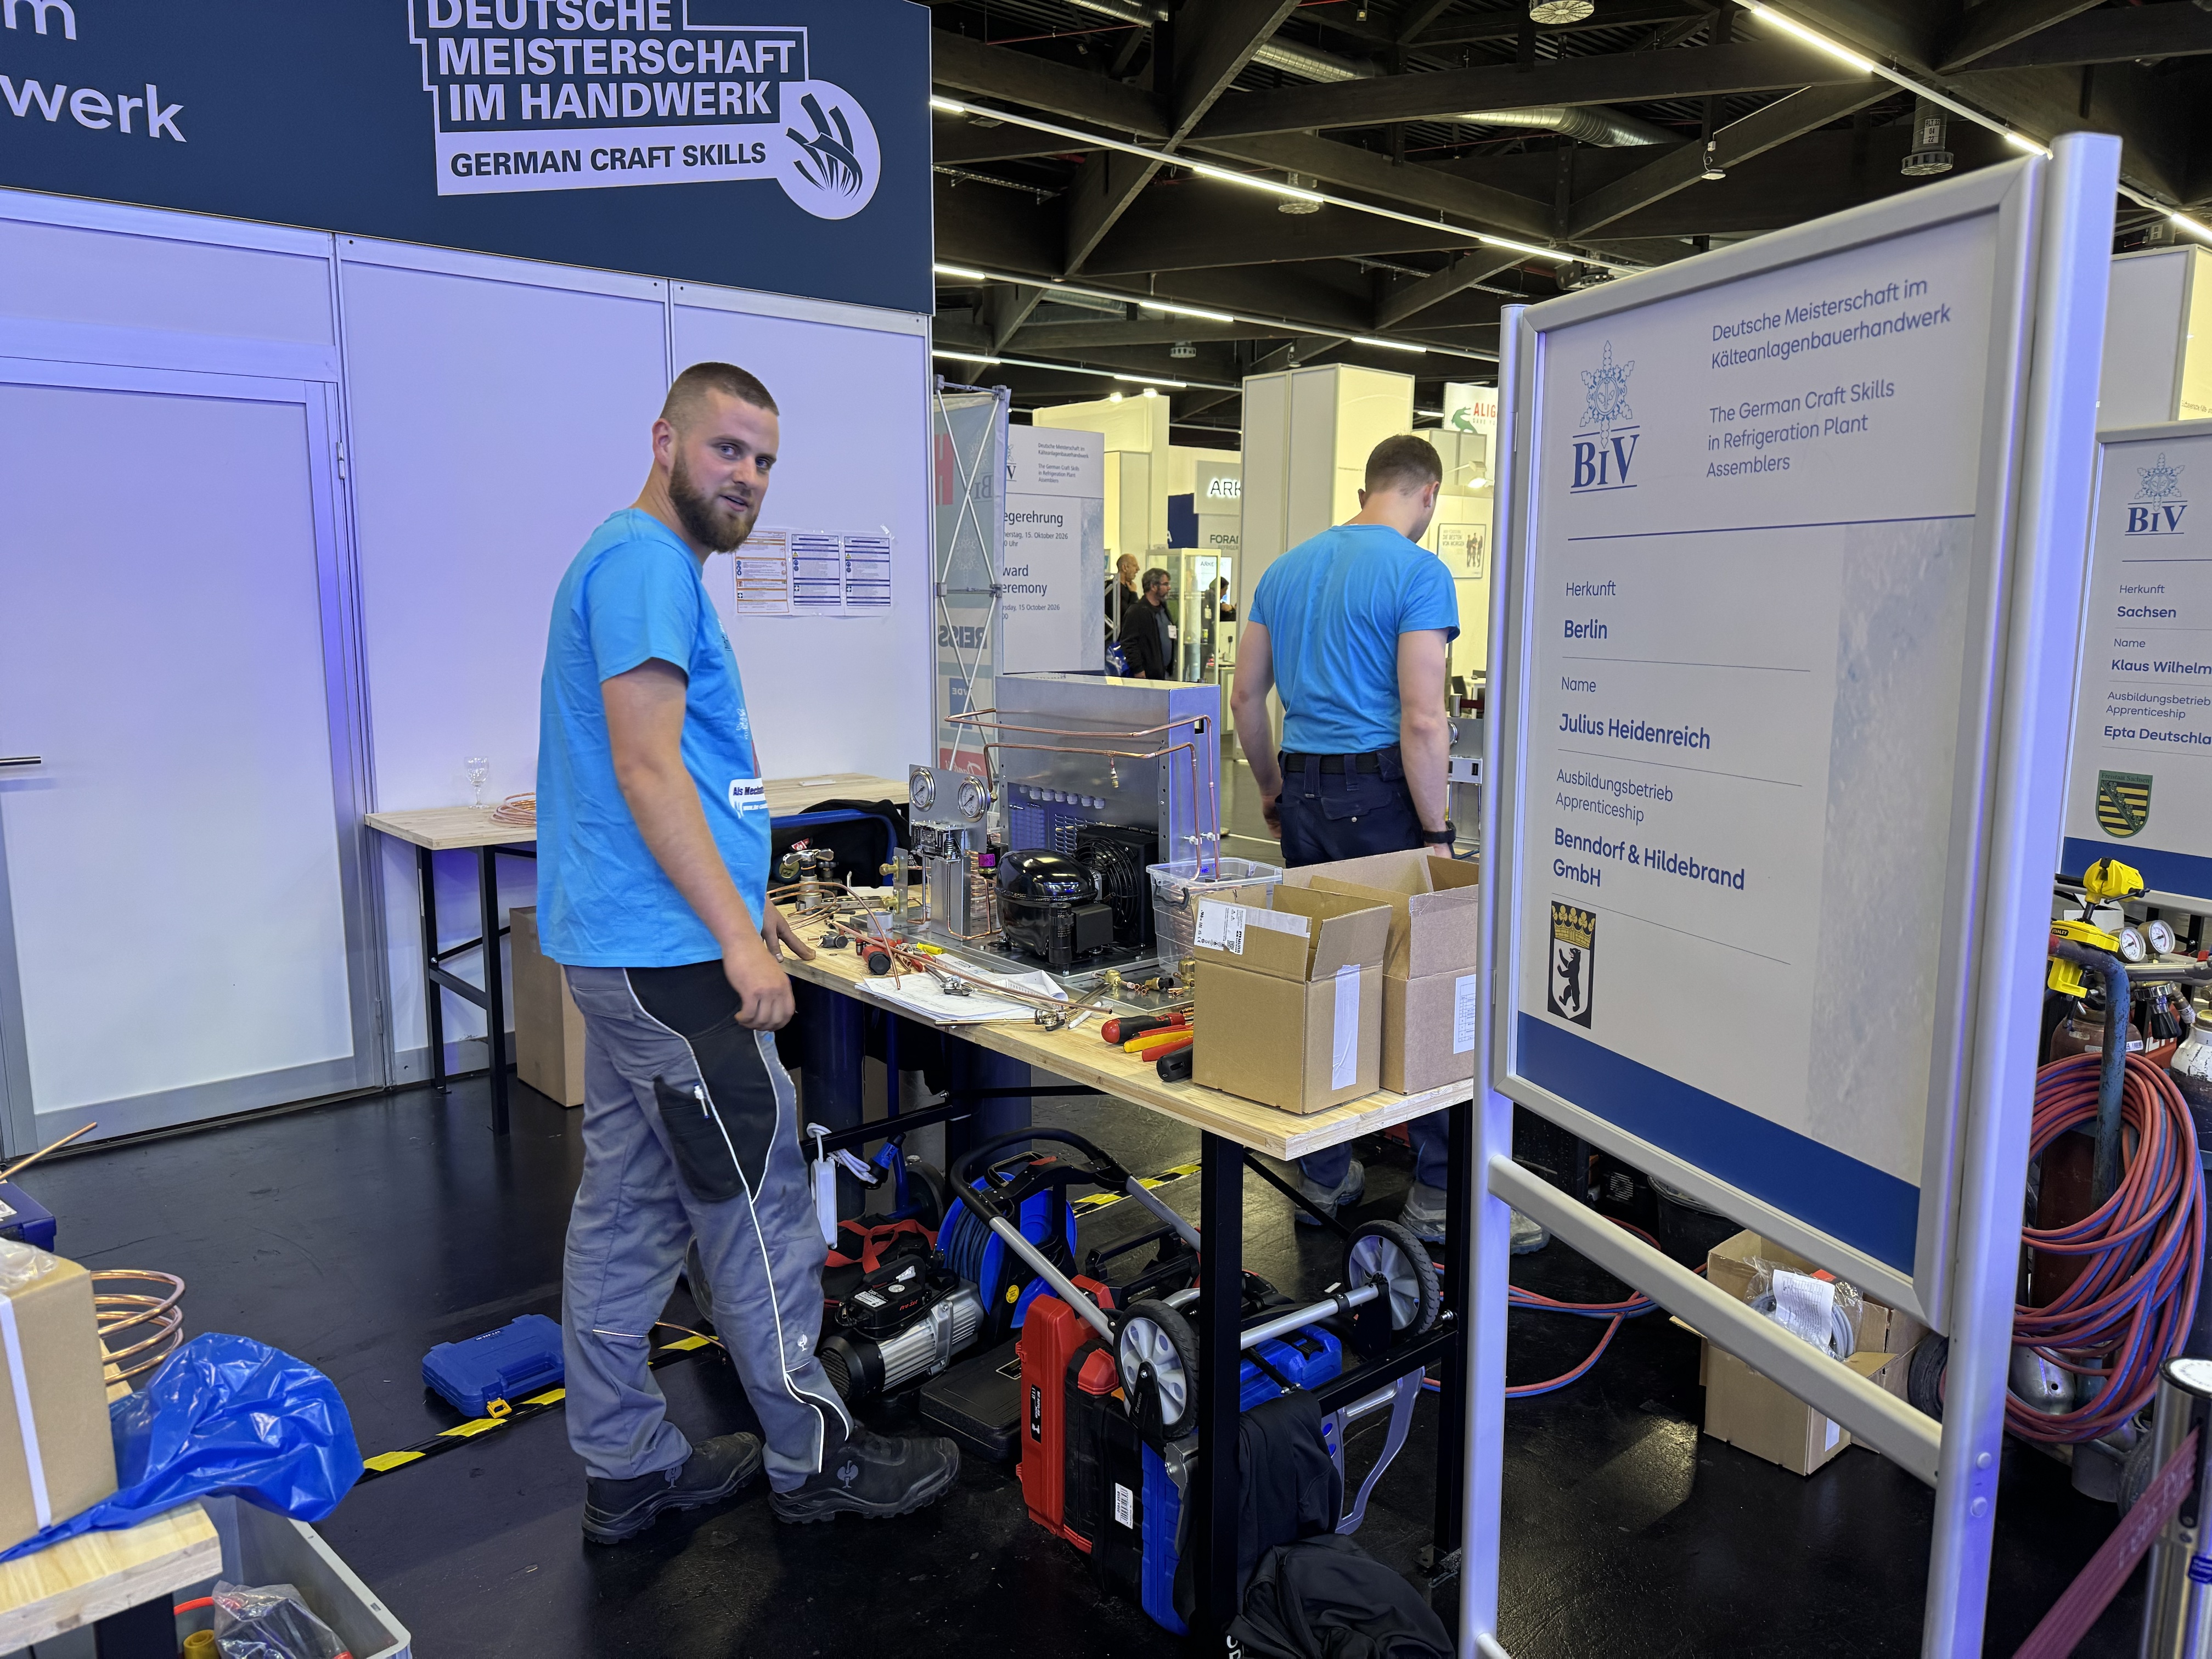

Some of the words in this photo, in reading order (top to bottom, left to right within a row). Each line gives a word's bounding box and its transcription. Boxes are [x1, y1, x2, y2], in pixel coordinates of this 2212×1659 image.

[428, 0, 671, 31] DEUTSCHE
[439, 37, 796, 76] MEISTERSCHAFT
[0, 75, 187, 143] werk
[450, 83, 504, 121] IM
[521, 81, 772, 120] HANDWERK
[451, 149, 582, 177] GERMAN
[590, 145, 676, 171] CRAFT
[682, 142, 767, 167] SKILLS
[1712, 313, 1781, 341] Deutsche
[1785, 283, 1899, 325] Meisterschaft
[1903, 279, 1927, 300] im
[1712, 303, 1951, 369] Kälteanlagenbauerhandwerk
[1709, 406, 1735, 423] The
[1739, 397, 1800, 419] German
[1805, 386, 1847, 409] Craft
[1850, 379, 1895, 402] Skills
[1708, 435, 1719, 451] in
[1724, 421, 1819, 449] Refrigeration
[1824, 414, 1868, 436] Plant
[1706, 455, 1790, 477] Assemblers
[1566, 580, 1617, 597] Herkunft
[2119, 584, 2165, 594] Herkunft
[2117, 605, 2177, 618] Sachsen
[1563, 618, 1608, 639] Berlin
[2113, 638, 2146, 650] Name
[2110, 659, 2150, 672] Klaus
[2153, 661, 2212, 675] Wilhelm
[1561, 676, 1597, 693] Name
[2107, 691, 2211, 706] Ausbildungsbetrieb
[2106, 705, 2186, 721] Apprenticeship
[1559, 713, 1605, 736] Julius
[1608, 718, 1710, 750] Heidenreich
[2104, 725, 2136, 740] Epta
[2139, 728, 2212, 745] Deutschla
[1556, 768, 1674, 802] Ausbildungsbetrieb
[2101, 772, 2125, 780] Freistaat
[2126, 775, 2150, 784] Sachsen
[1555, 791, 1645, 826] Apprenticeship
[1553, 858, 1601, 887] GmbH
[1554, 827, 1625, 861] Benndorf
[1628, 843, 1640, 865] &
[1644, 847, 1745, 891] Hildebrand
